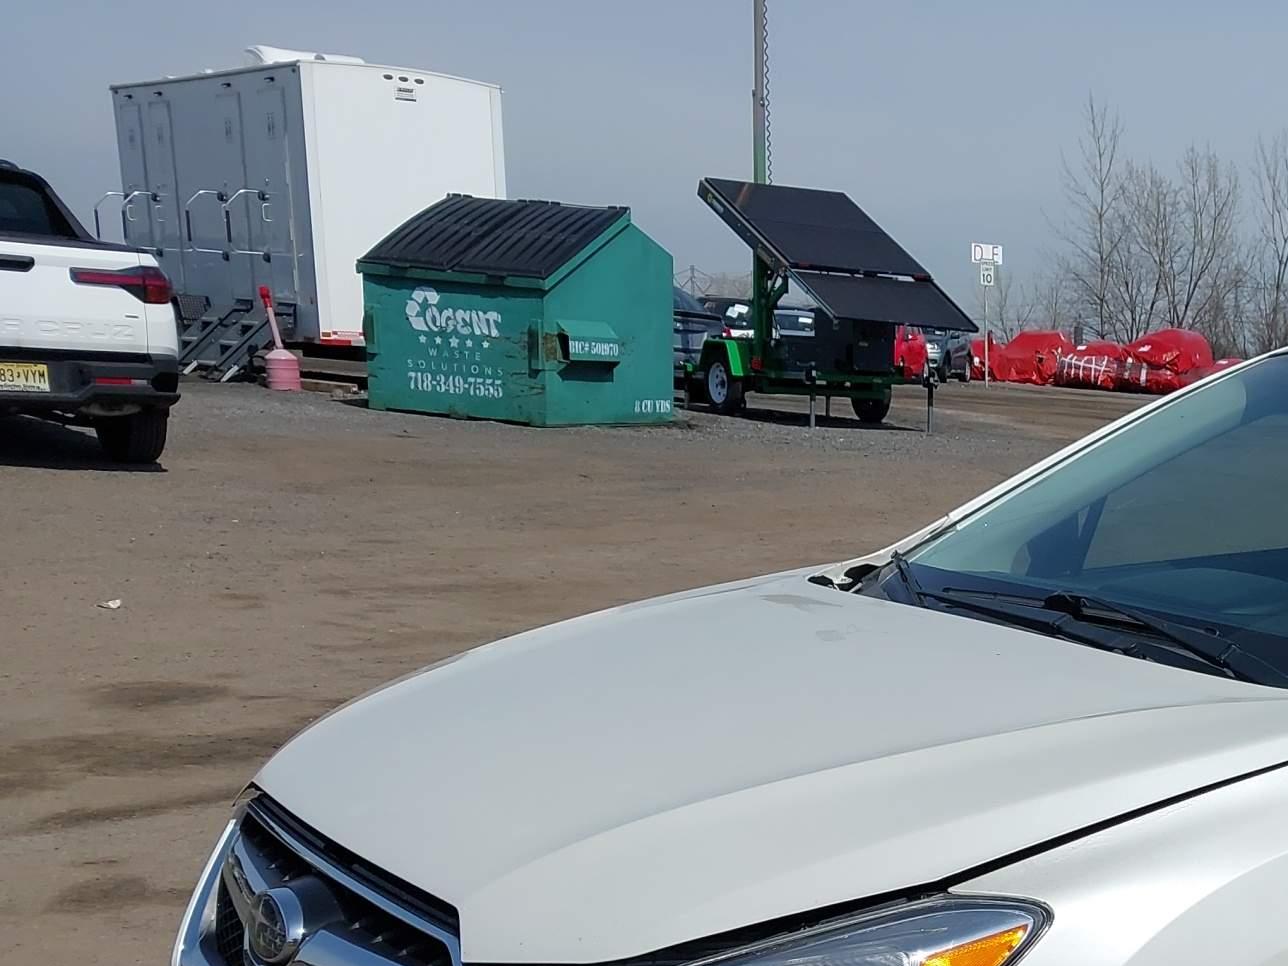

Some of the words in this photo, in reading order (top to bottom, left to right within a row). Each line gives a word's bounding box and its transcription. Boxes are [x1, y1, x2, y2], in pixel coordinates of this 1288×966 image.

[974, 244, 983, 261] D
[982, 273, 992, 283] 10
[428, 347, 481, 361] WASTE
[591, 341, 619, 356] 501970
[407, 359, 503, 377] SOLUTIONS
[408, 371, 503, 399] 718-349-7555
[641, 400, 654, 413] CU
[655, 400, 671, 413] YDS
